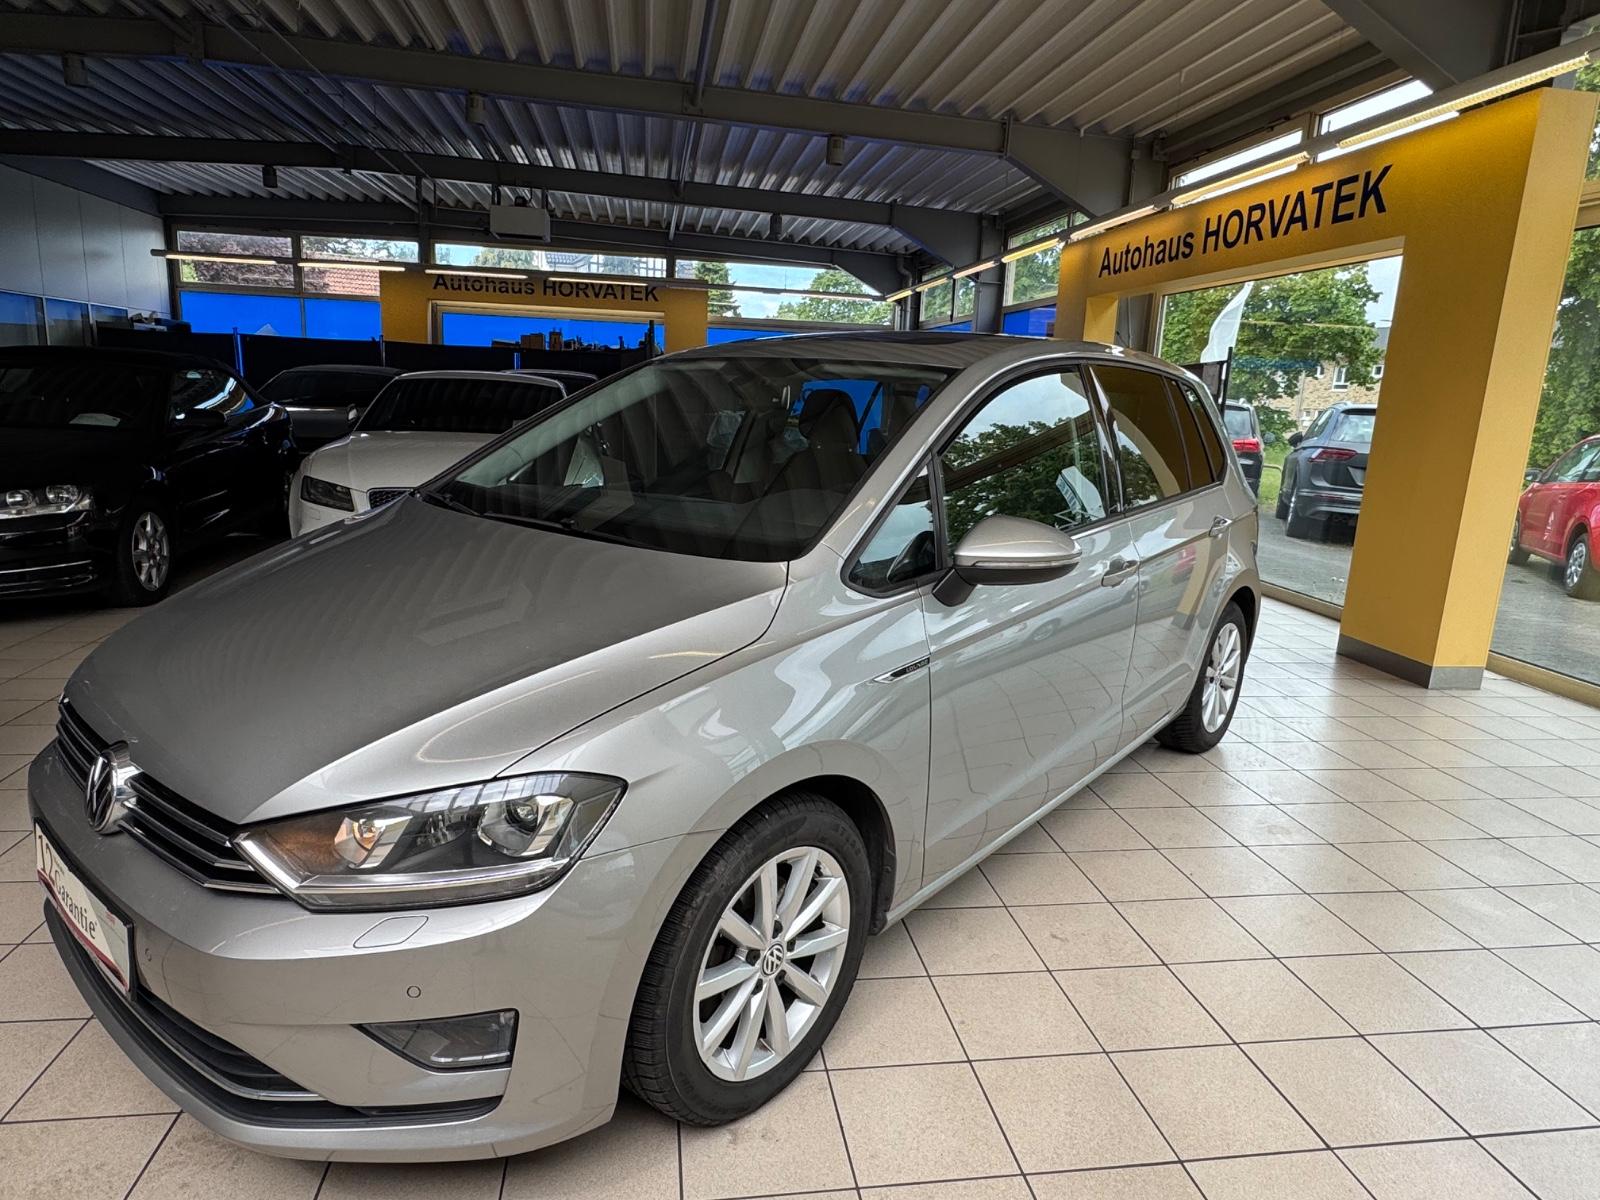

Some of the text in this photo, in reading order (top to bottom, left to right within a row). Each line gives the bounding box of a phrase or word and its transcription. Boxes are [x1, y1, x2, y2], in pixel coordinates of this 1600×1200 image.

[1098, 164, 1393, 278] Autohaus HORVATEK
[432, 274, 659, 302] Autohaus HORVATEK
